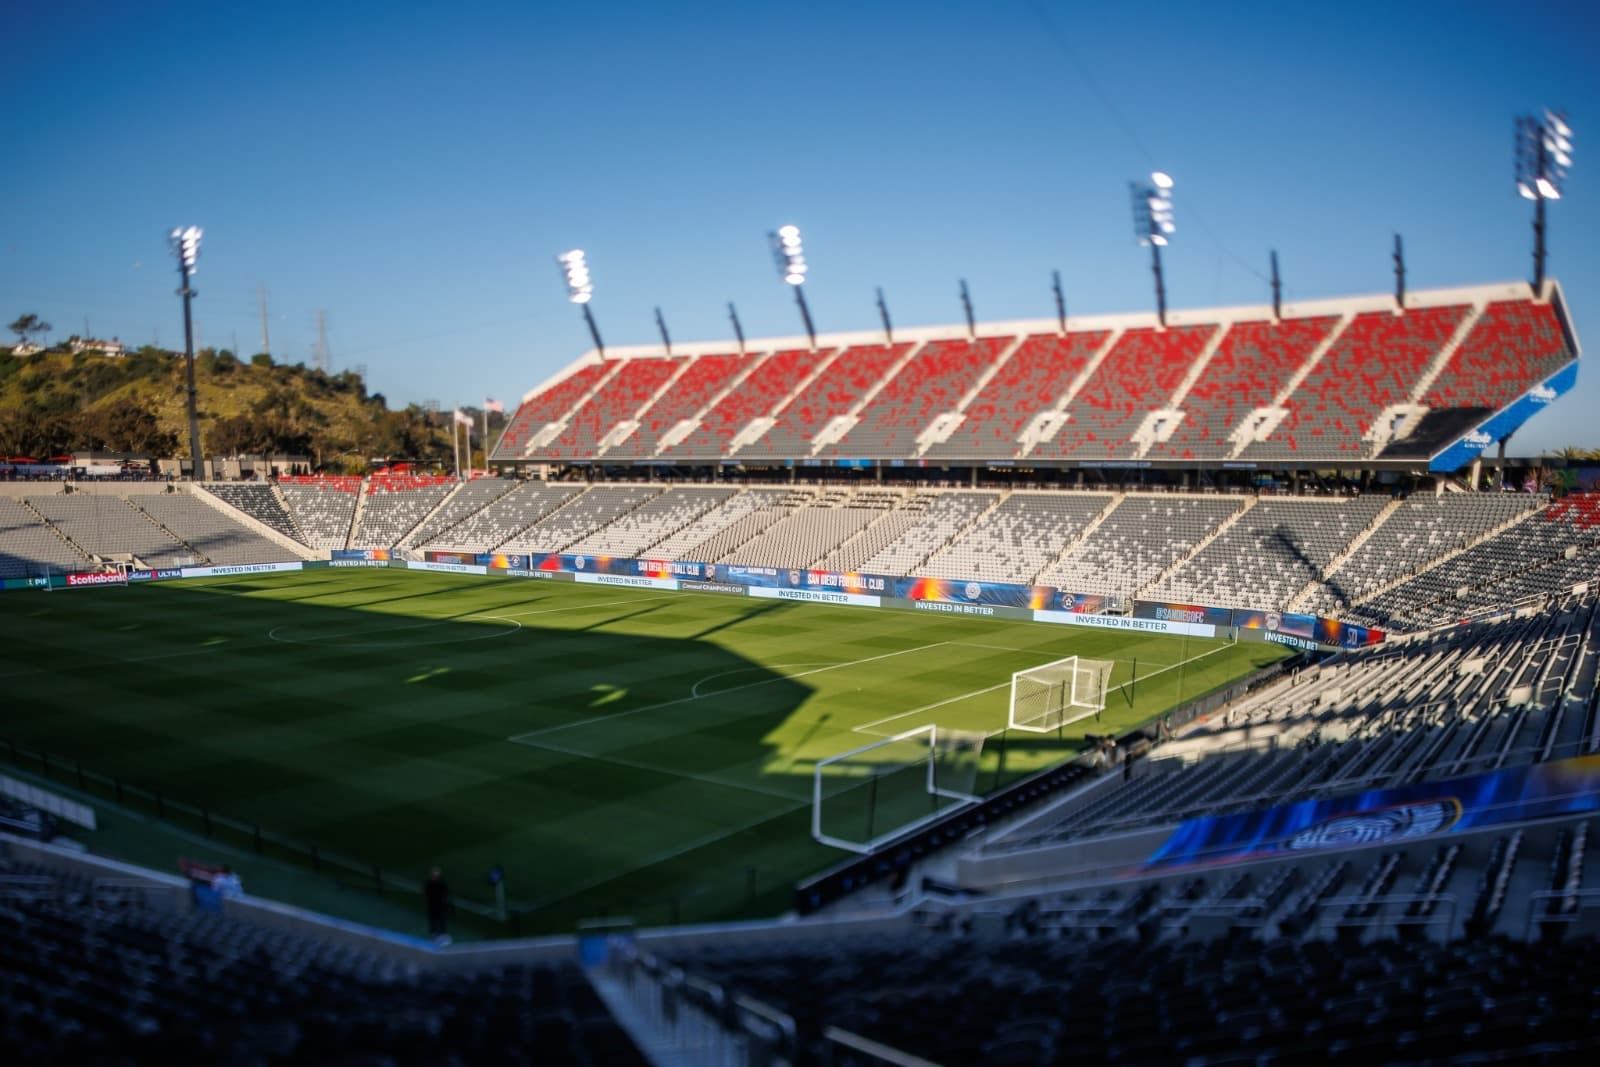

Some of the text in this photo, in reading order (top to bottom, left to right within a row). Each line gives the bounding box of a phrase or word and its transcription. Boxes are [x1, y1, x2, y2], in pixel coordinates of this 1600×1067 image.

[211, 567, 243, 575] INVESTED
[252, 564, 276, 573] BETTER
[70, 573, 125, 585] Scotiabank
[598, 576, 652, 586] INVESTED IN BETTER
[808, 574, 884, 591] SAN DIEGO FOOTBALL CLUB
[702, 584, 731, 592] CHAMPIONS
[778, 590, 811, 600] INVESTED
[821, 593, 848, 603] BETTER
[915, 602, 994, 616] INVESTED IN BETTER
[1075, 615, 1167, 631] INVESTED IN BETTER
[1264, 632, 1298, 647] INVESTED
[1298, 639, 1305, 649] IN
